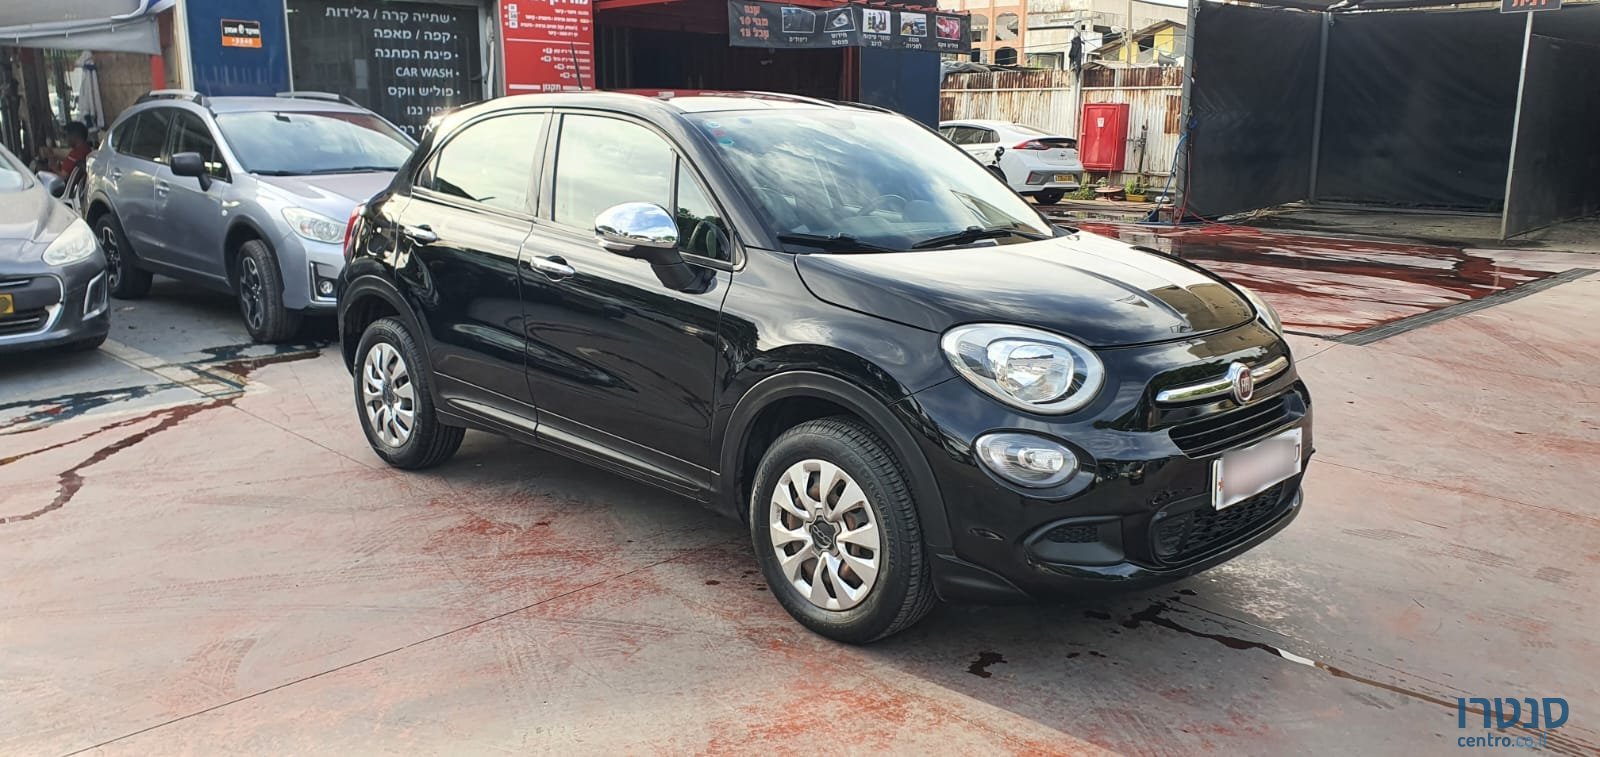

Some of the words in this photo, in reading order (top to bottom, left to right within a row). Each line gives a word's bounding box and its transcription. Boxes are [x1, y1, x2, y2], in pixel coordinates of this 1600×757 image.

[325, 6, 370, 19] גלידות
[381, 10, 409, 23] קרה
[412, 12, 450, 24] שתייה
[373, 28, 412, 40] מאפה
[423, 30, 451, 44] קפה
[374, 48, 420, 59] המתנה
[423, 50, 452, 60] פינת
[395, 66, 418, 78] CAR
[420, 67, 454, 79] WASH
[387, 86, 415, 99] ווקס
[418, 85, 454, 97] פוליש
[406, 105, 423, 116] ננו
